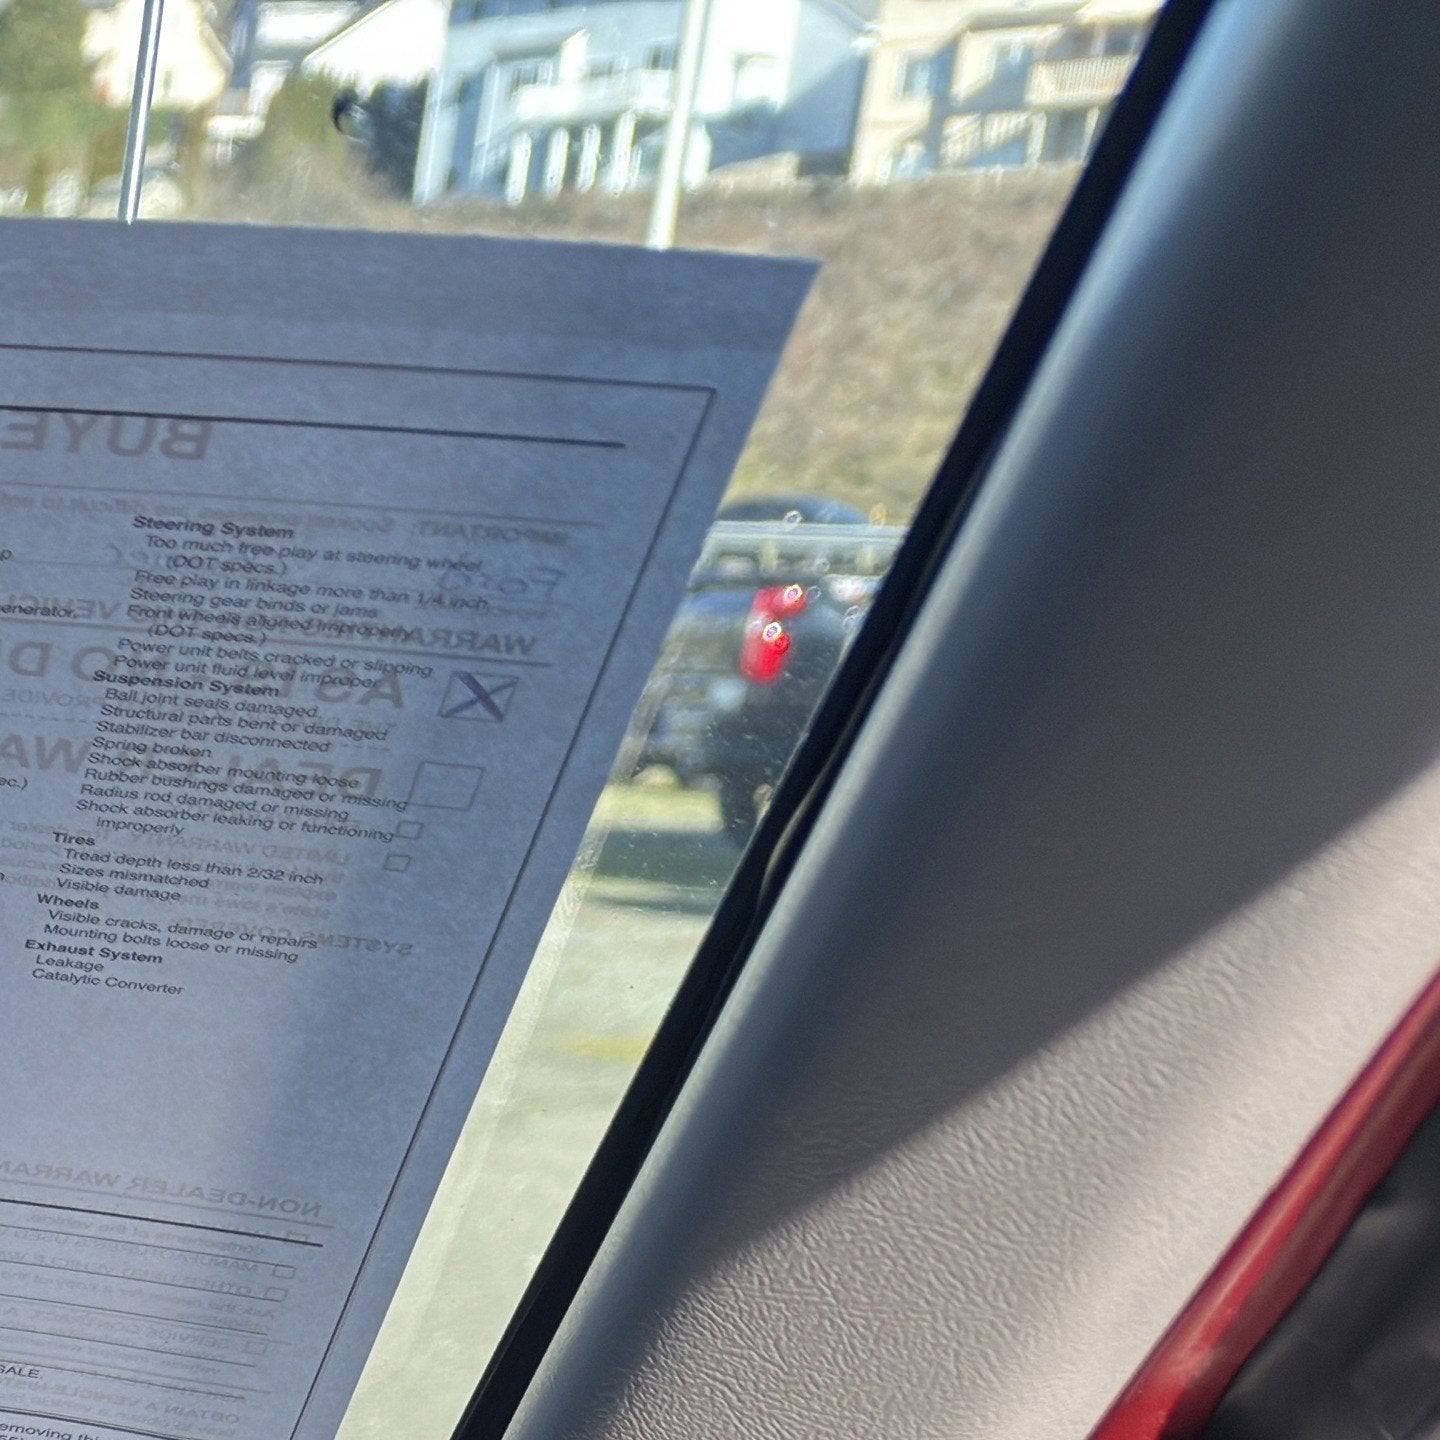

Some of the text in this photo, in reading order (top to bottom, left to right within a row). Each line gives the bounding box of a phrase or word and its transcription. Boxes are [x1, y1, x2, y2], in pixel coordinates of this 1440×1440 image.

[134, 516, 294, 539] Steering System
[94, 671, 280, 698] Suspension System
[93, 737, 211, 758] Spring broken
[53, 832, 96, 846] Tires
[37, 894, 100, 910] Wheels
[25, 939, 162, 964] Exhaust System
[36, 955, 104, 973] Leakage
[32, 968, 184, 995] Catalytic Converter
